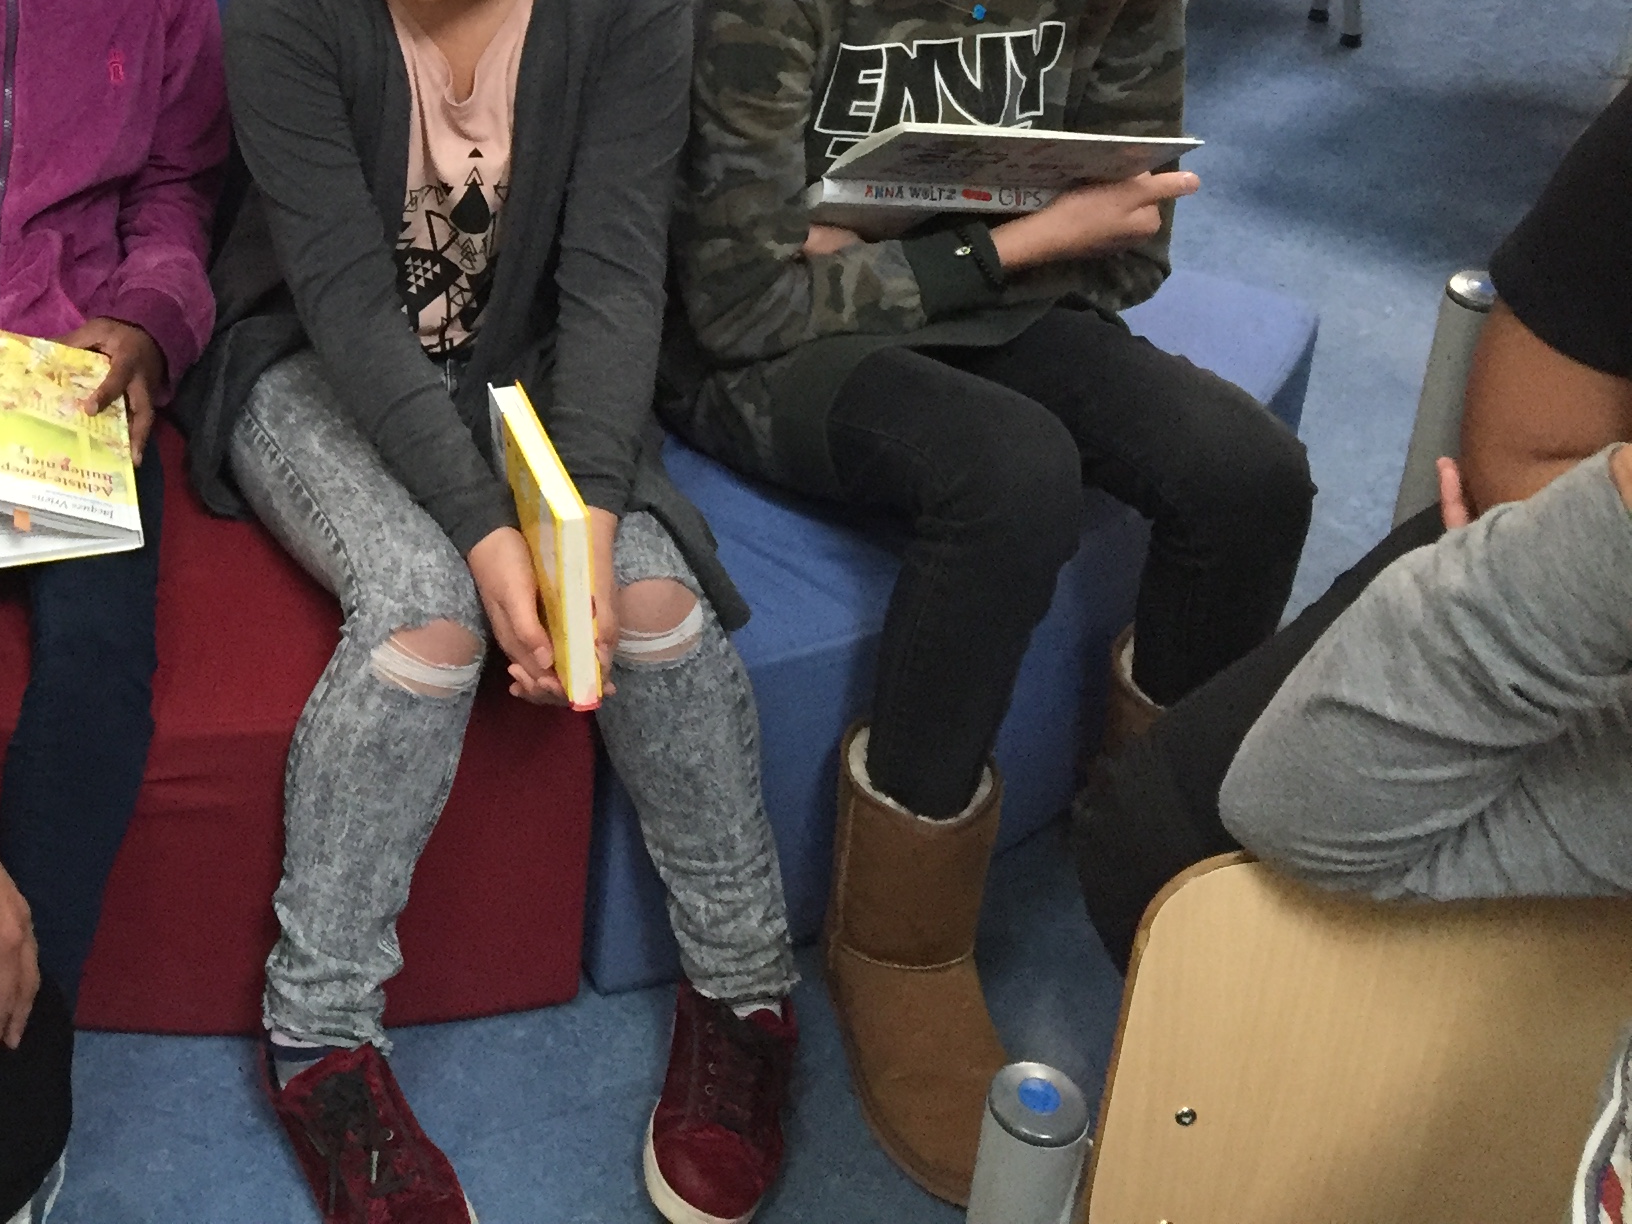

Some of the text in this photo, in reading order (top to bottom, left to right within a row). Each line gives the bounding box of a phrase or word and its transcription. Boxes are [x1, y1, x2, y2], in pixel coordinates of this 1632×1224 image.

[864, 184, 905, 200] ANNA
[909, 185, 957, 201] WOLTZ
[25, 456, 56, 469] niet
